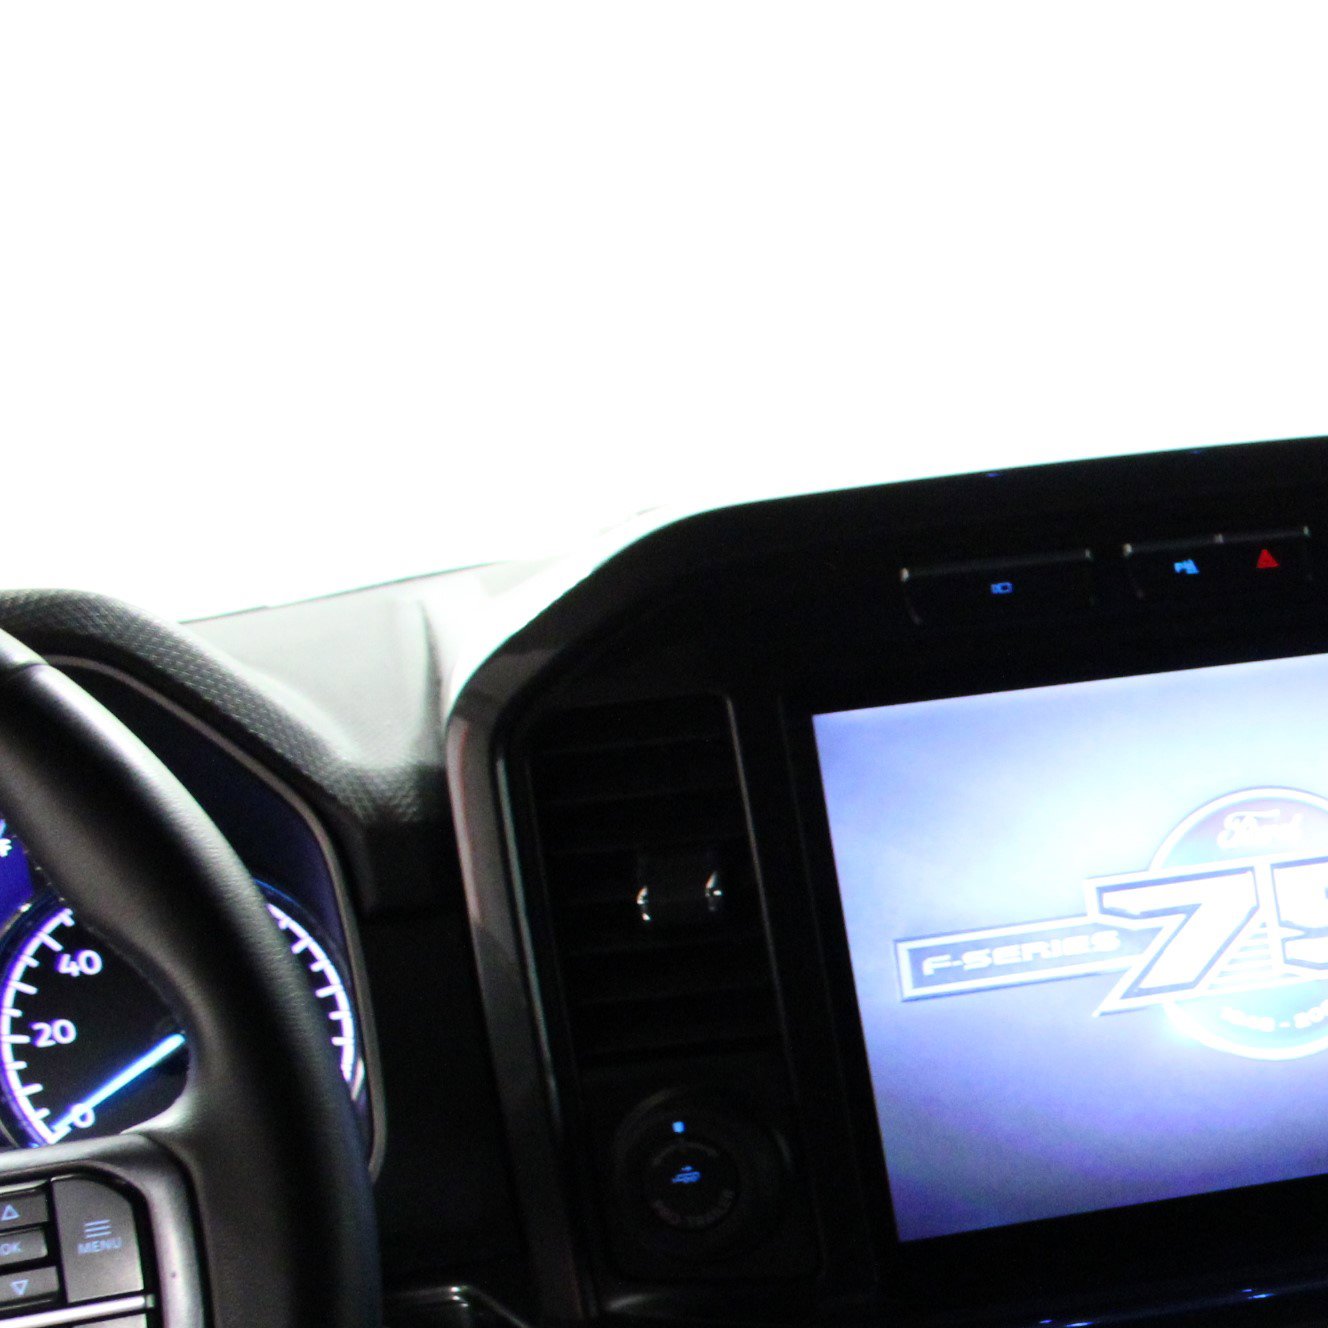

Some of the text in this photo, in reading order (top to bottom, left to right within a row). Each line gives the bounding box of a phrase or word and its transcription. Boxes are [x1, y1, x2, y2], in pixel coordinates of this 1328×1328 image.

[57, 949, 103, 977] 40
[921, 929, 1120, 976] F-SERIES
[30, 1018, 77, 1048] 20
[77, 1237, 123, 1255] MENU
